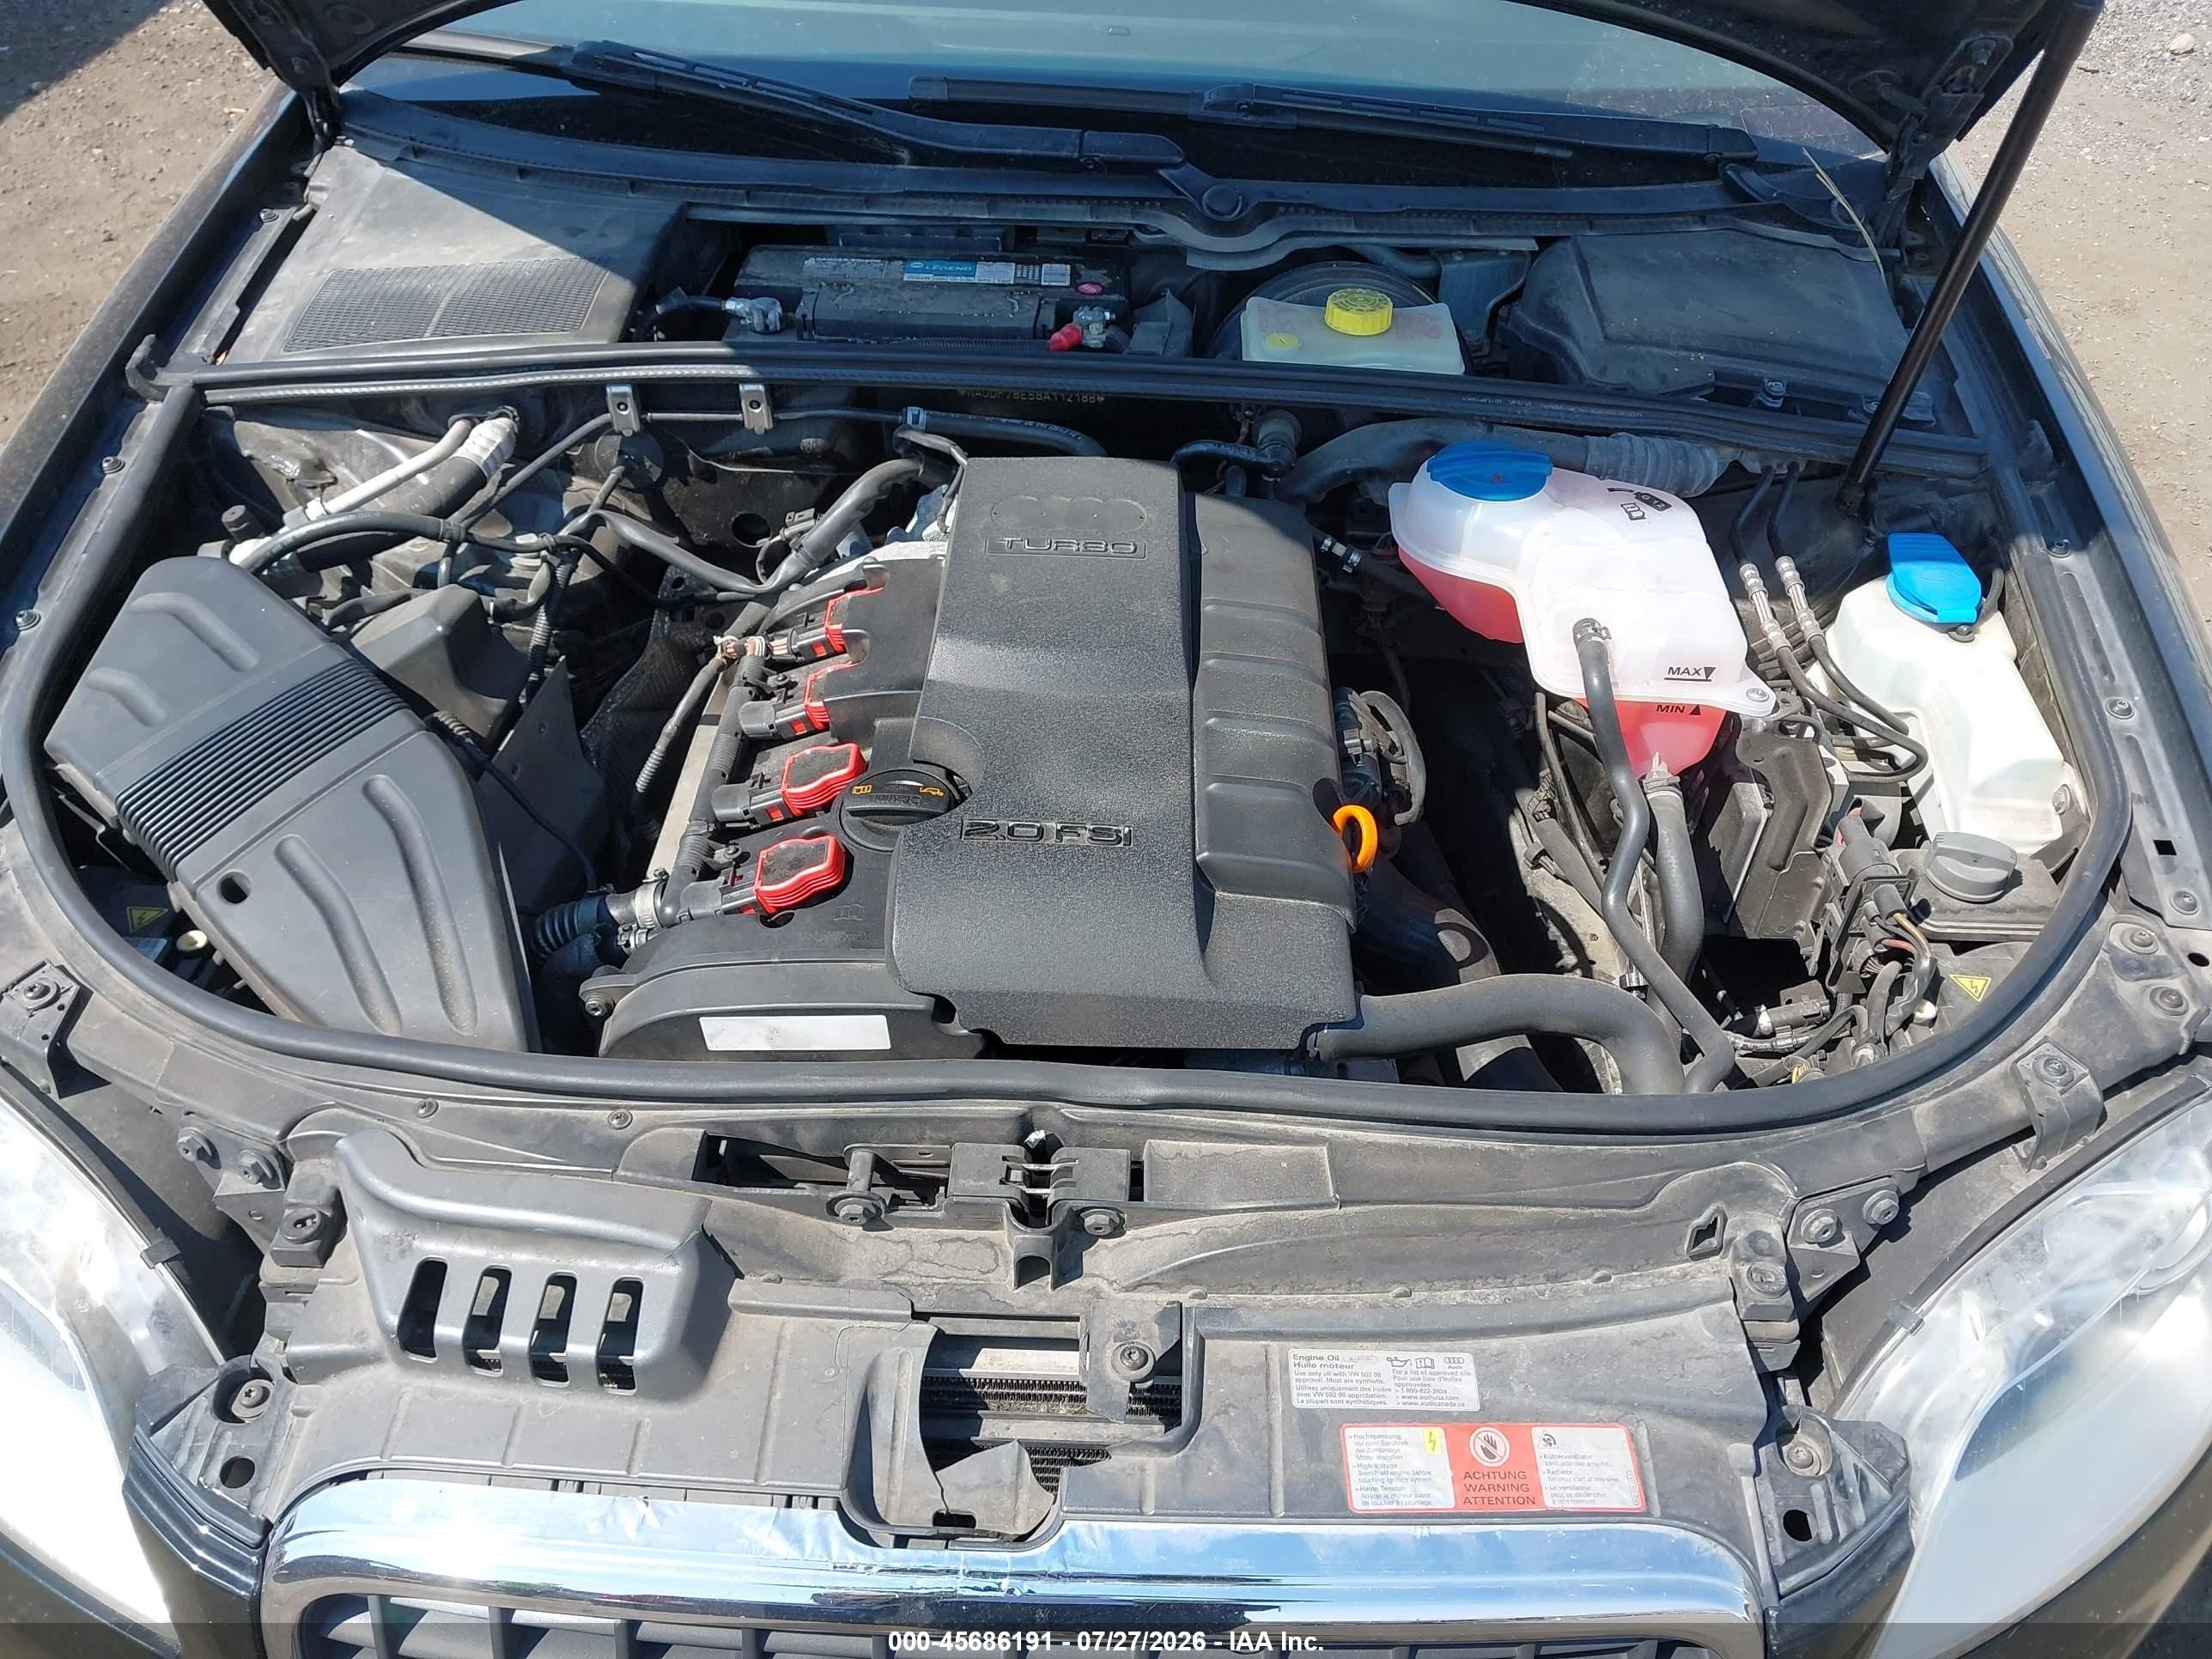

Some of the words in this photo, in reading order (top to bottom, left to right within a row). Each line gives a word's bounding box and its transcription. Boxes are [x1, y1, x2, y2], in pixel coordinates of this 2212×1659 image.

[996, 537, 1138, 554] TURBO
[1668, 666, 1702, 676] MAX
[964, 819, 1044, 842] 2.0
[1055, 823, 1133, 847] FSI
[1463, 1471, 1527, 1480] ACHTUNG
[1463, 1496, 1535, 1504] ATTENTION
